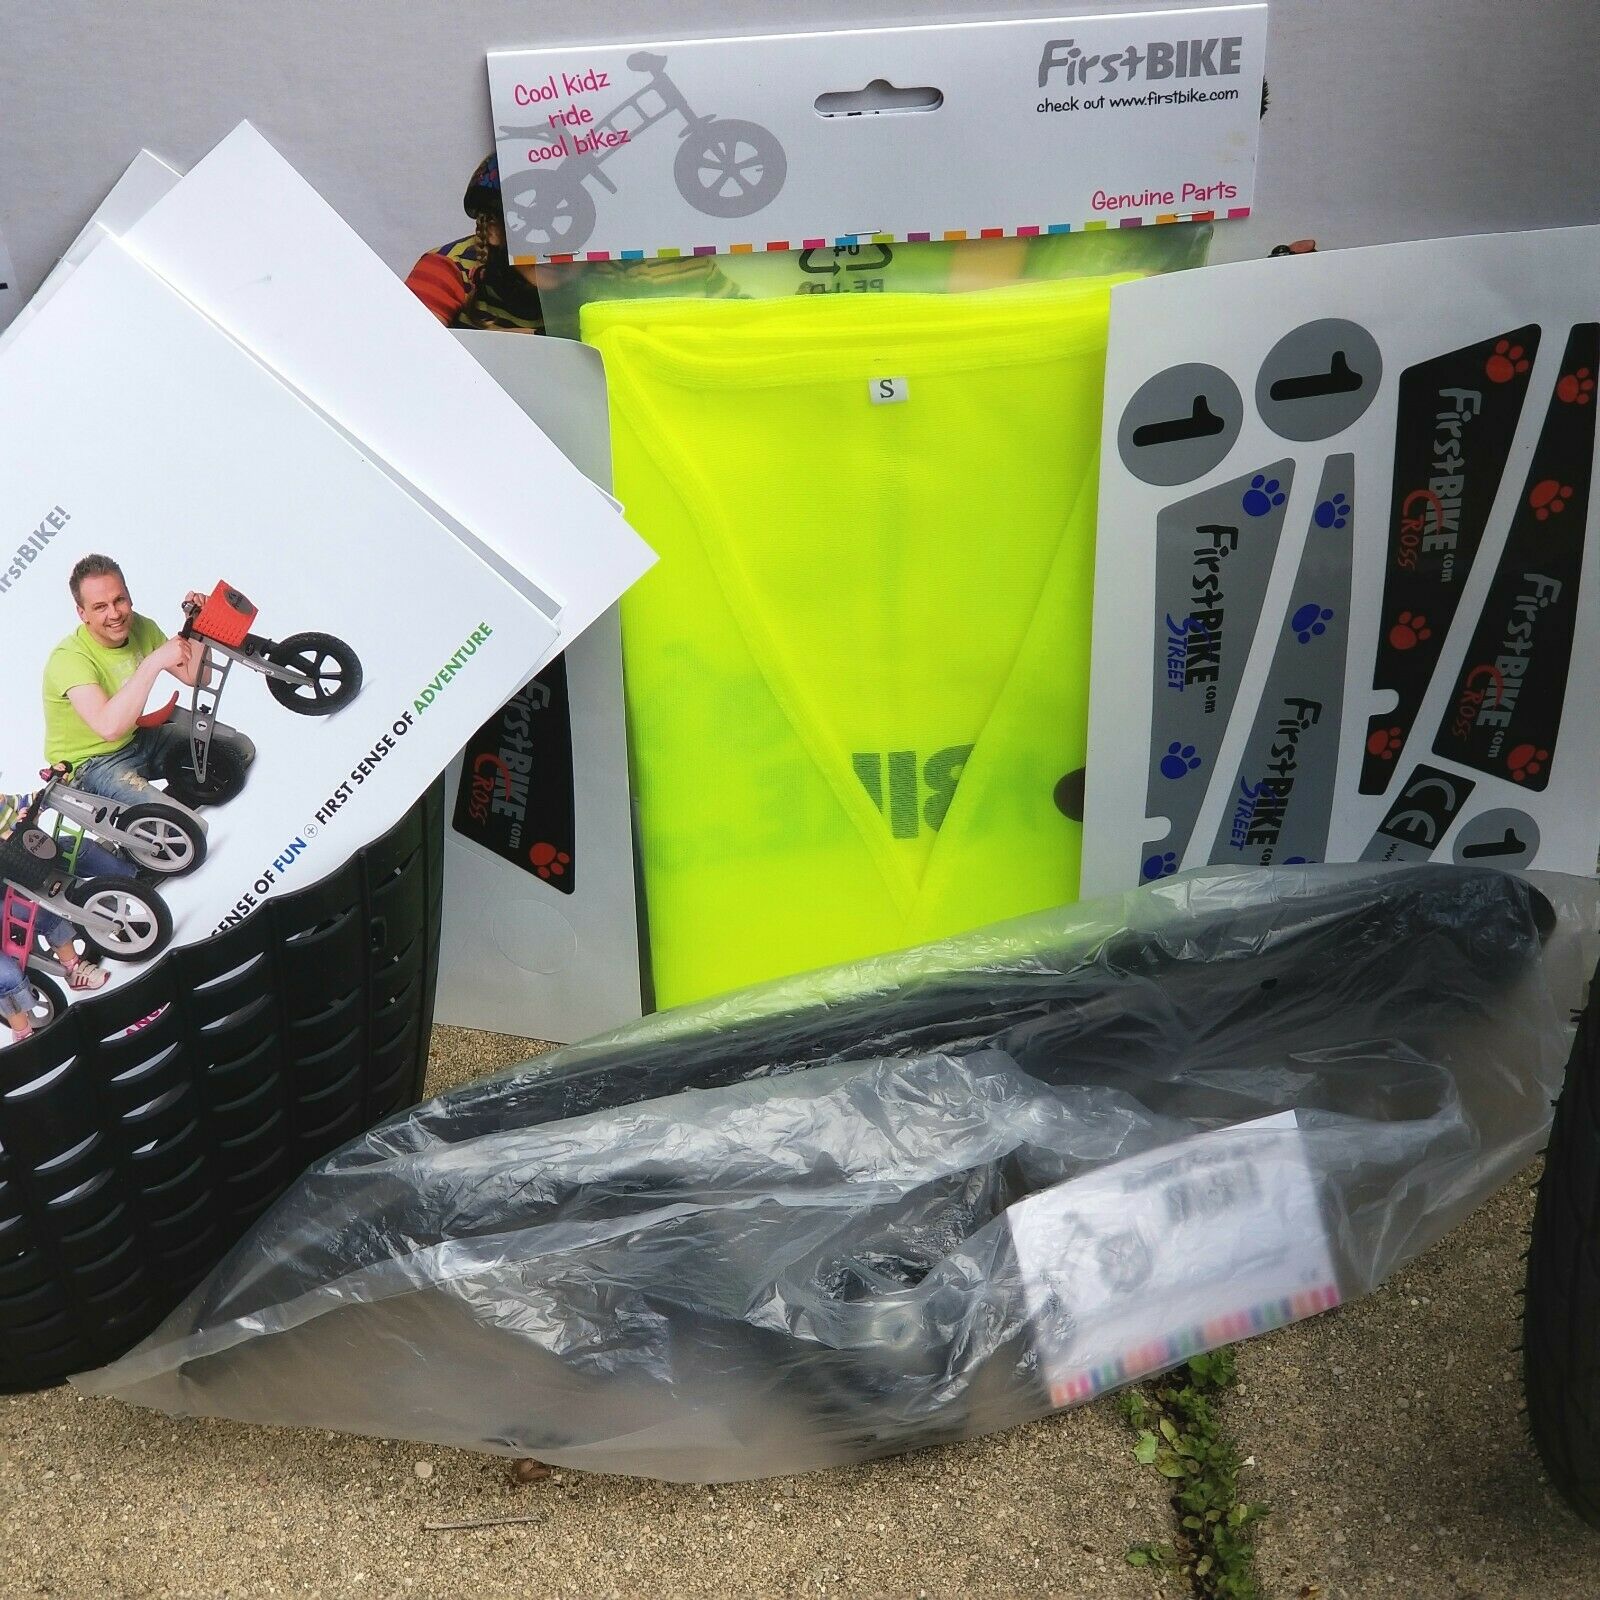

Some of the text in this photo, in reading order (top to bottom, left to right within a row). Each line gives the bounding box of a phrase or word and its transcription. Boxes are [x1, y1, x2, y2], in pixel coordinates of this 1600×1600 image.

[1038, 36, 1243, 89] FirstBIKE
[514, 68, 611, 106] Cool kidz
[1036, 88, 1239, 113] check out www.firstbike.com
[548, 104, 594, 129] ride
[528, 127, 632, 163] cool bikez
[1091, 180, 1238, 211] Genuine Parts
[879, 378, 895, 399] S
[254, 869, 276, 895] OF
[272, 836, 308, 874] FUN
[314, 780, 354, 825] FIRST
[351, 734, 396, 785] SENSE
[392, 711, 416, 737] OF
[412, 621, 494, 716] ADVENTURE
